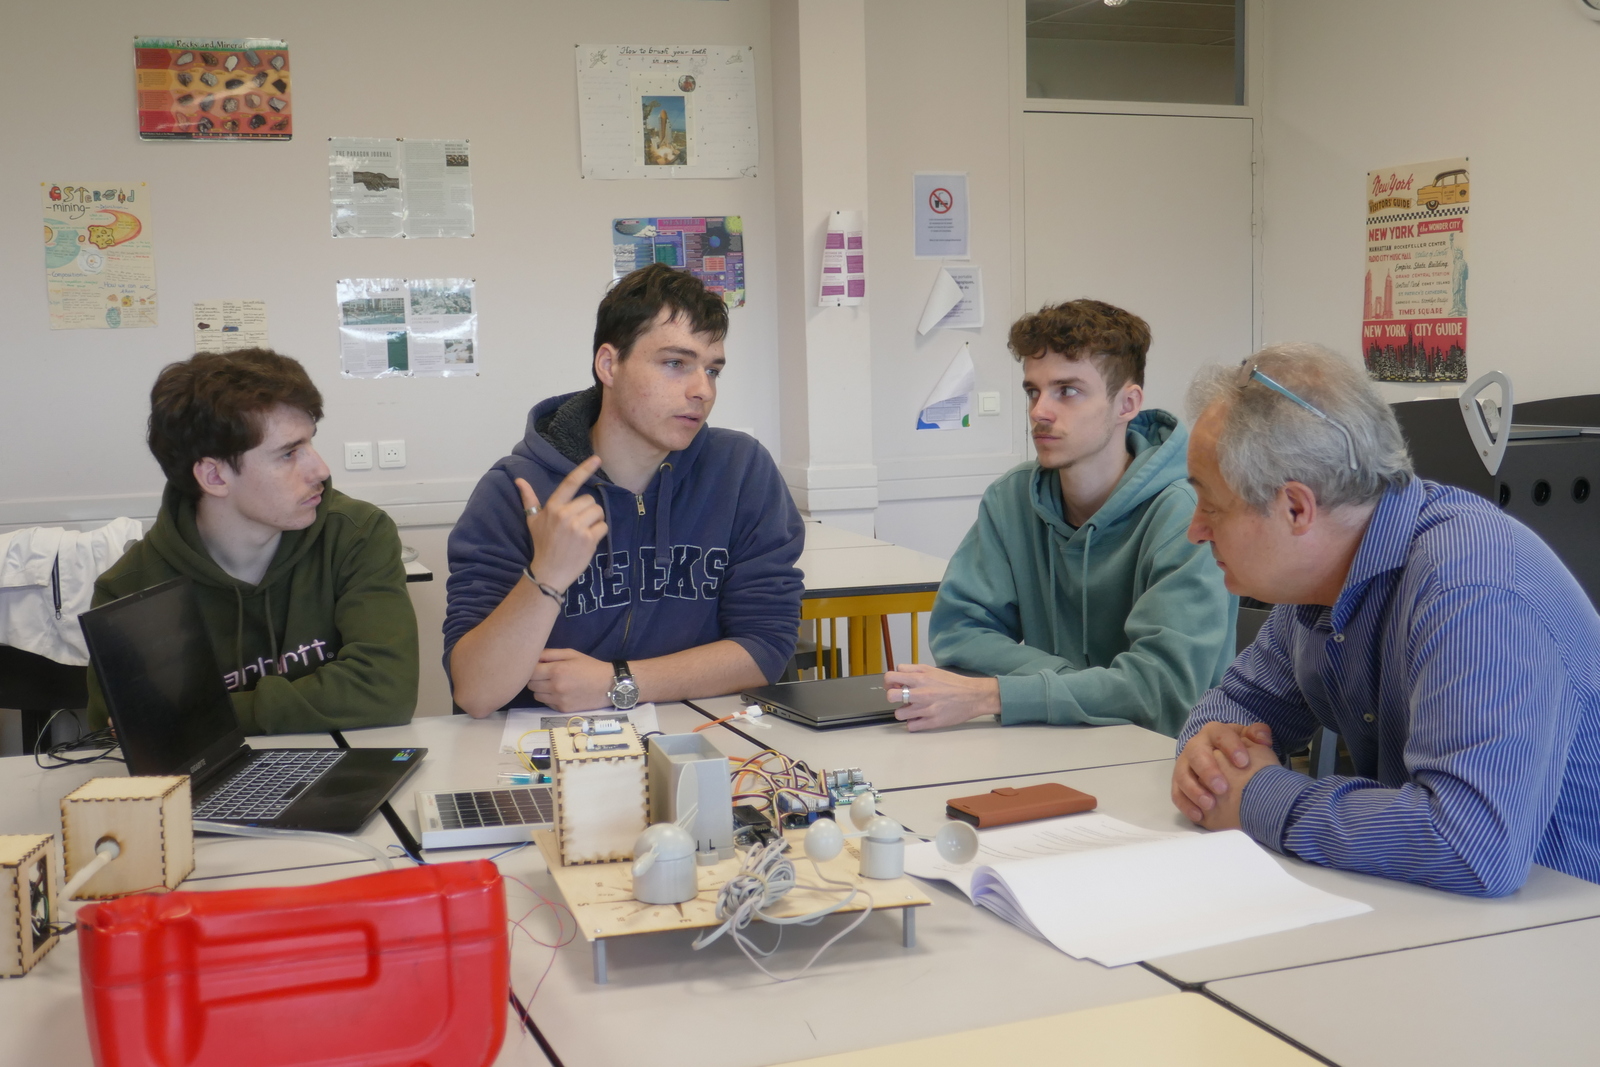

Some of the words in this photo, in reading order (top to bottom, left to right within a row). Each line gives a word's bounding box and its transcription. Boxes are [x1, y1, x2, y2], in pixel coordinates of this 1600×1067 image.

[176, 40, 198, 48] Rocks
[217, 40, 249, 49] Minerals
[620, 46, 637, 54] How
[648, 47, 669, 55] brush
[671, 49, 689, 57] your
[1371, 175, 1390, 197] New
[1387, 173, 1414, 196] York
[1393, 198, 1410, 208] GUIDE
[1368, 227, 1388, 242] NEW
[1389, 224, 1415, 240] YORK
[1420, 224, 1428, 232] the
[1428, 222, 1449, 231] WONDER
[1449, 221, 1461, 230] CITY
[1395, 264, 1412, 272] Empire
[1428, 260, 1448, 268] Building
[1418, 308, 1442, 316] SQUARE
[1364, 325, 1382, 338] NEW
[1384, 324, 1406, 337] YORK
[1414, 323, 1433, 336] CITY
[1436, 322, 1463, 336] GUIDE
